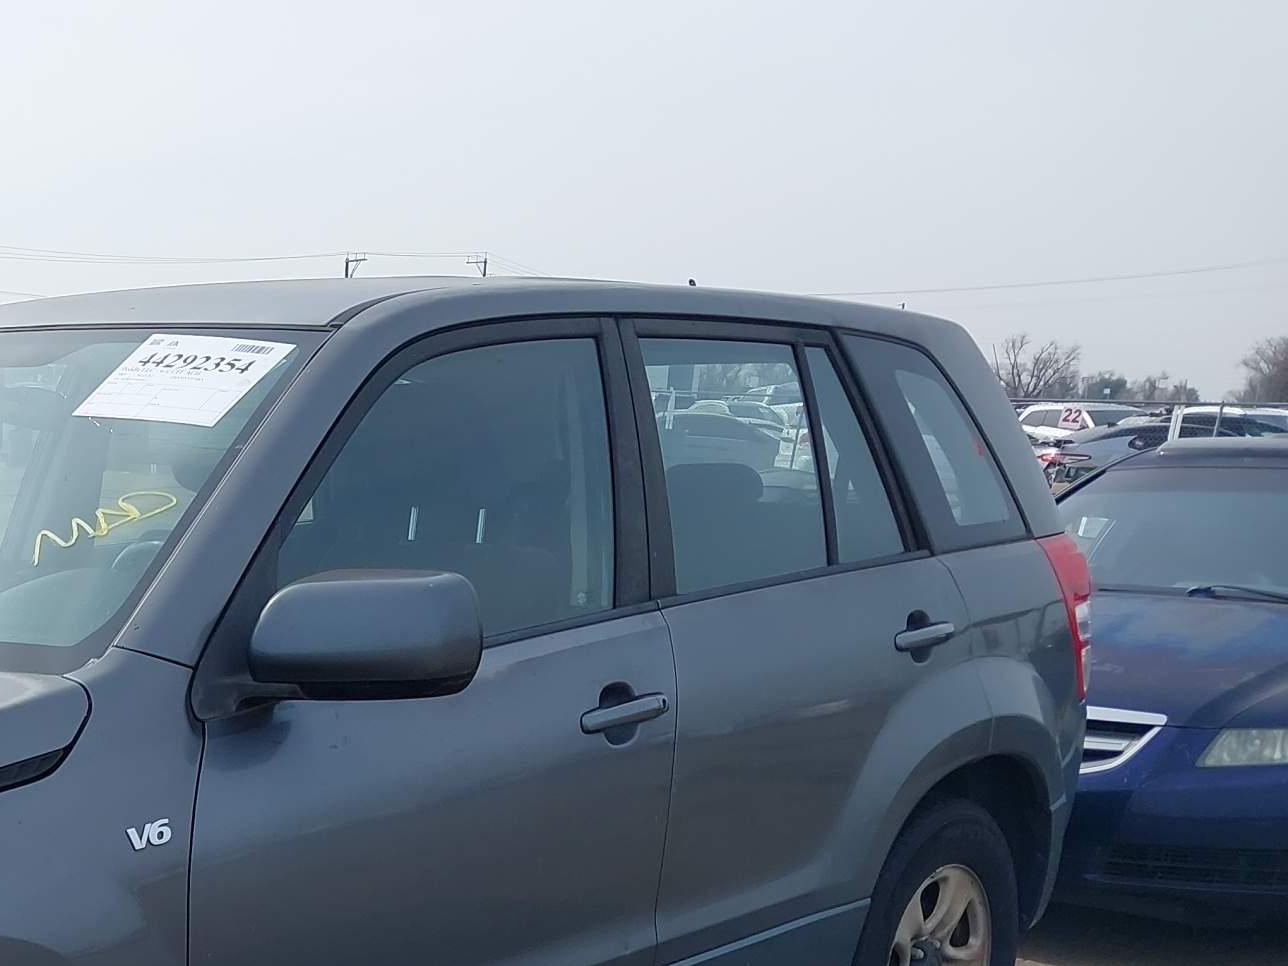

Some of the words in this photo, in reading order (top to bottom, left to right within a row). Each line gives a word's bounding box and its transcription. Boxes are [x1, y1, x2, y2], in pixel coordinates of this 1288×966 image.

[138, 351, 257, 375] 44292354
[1062, 408, 1082, 423] 22
[125, 818, 172, 850] V6
